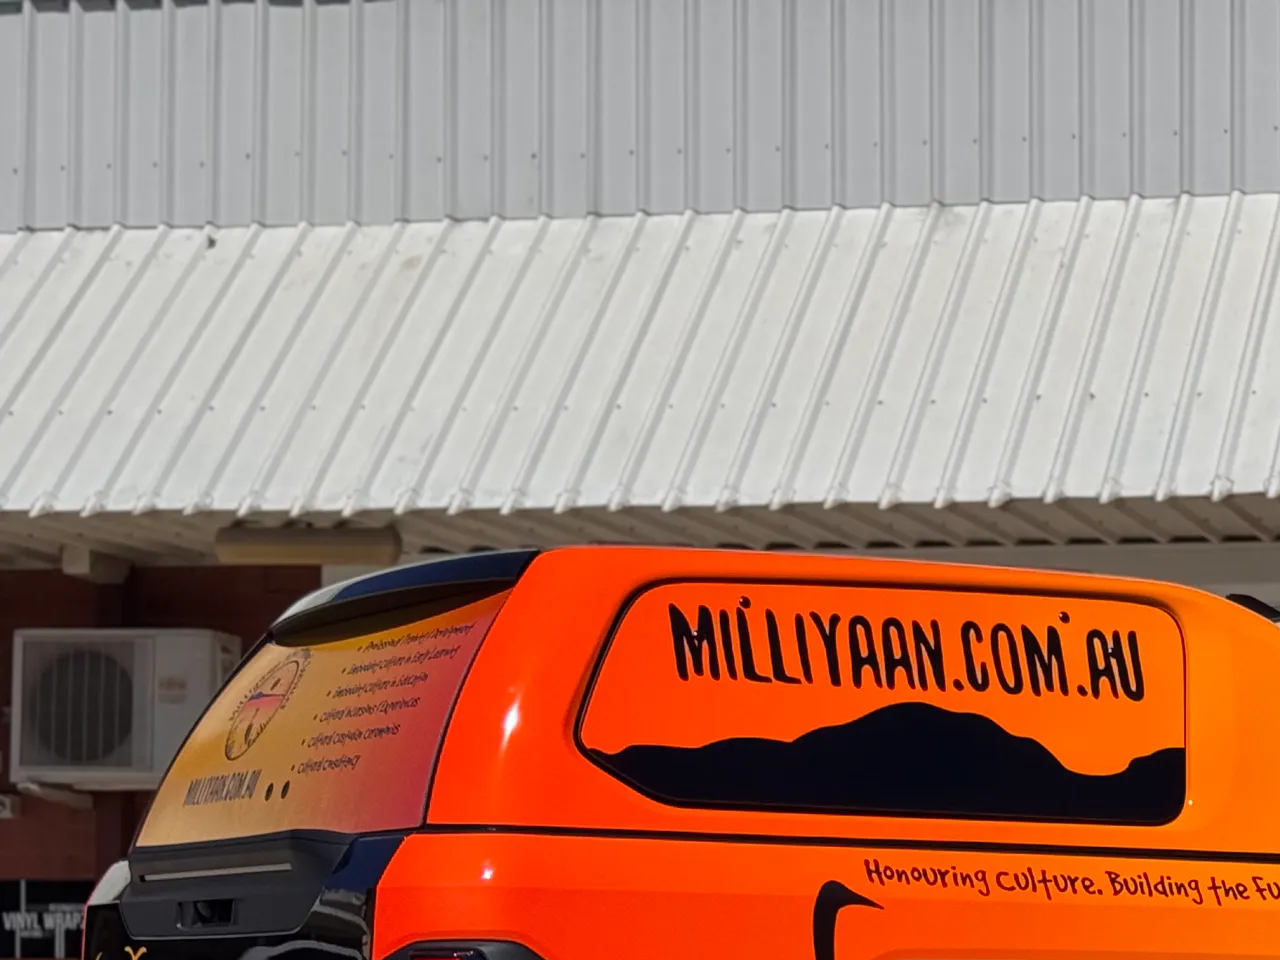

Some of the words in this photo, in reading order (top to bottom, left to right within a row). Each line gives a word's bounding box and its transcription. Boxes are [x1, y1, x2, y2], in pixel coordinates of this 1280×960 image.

[411, 650, 430, 664] Early
[428, 645, 461, 659] Learning
[669, 601, 1145, 701] MILLIYAAN.COM.AU
[380, 697, 421, 715] Experiences
[864, 859, 990, 896] Honouring
[1105, 870, 1203, 905] Building
[1207, 876, 1250, 906] the
[2, 912, 40, 931] VINYL
